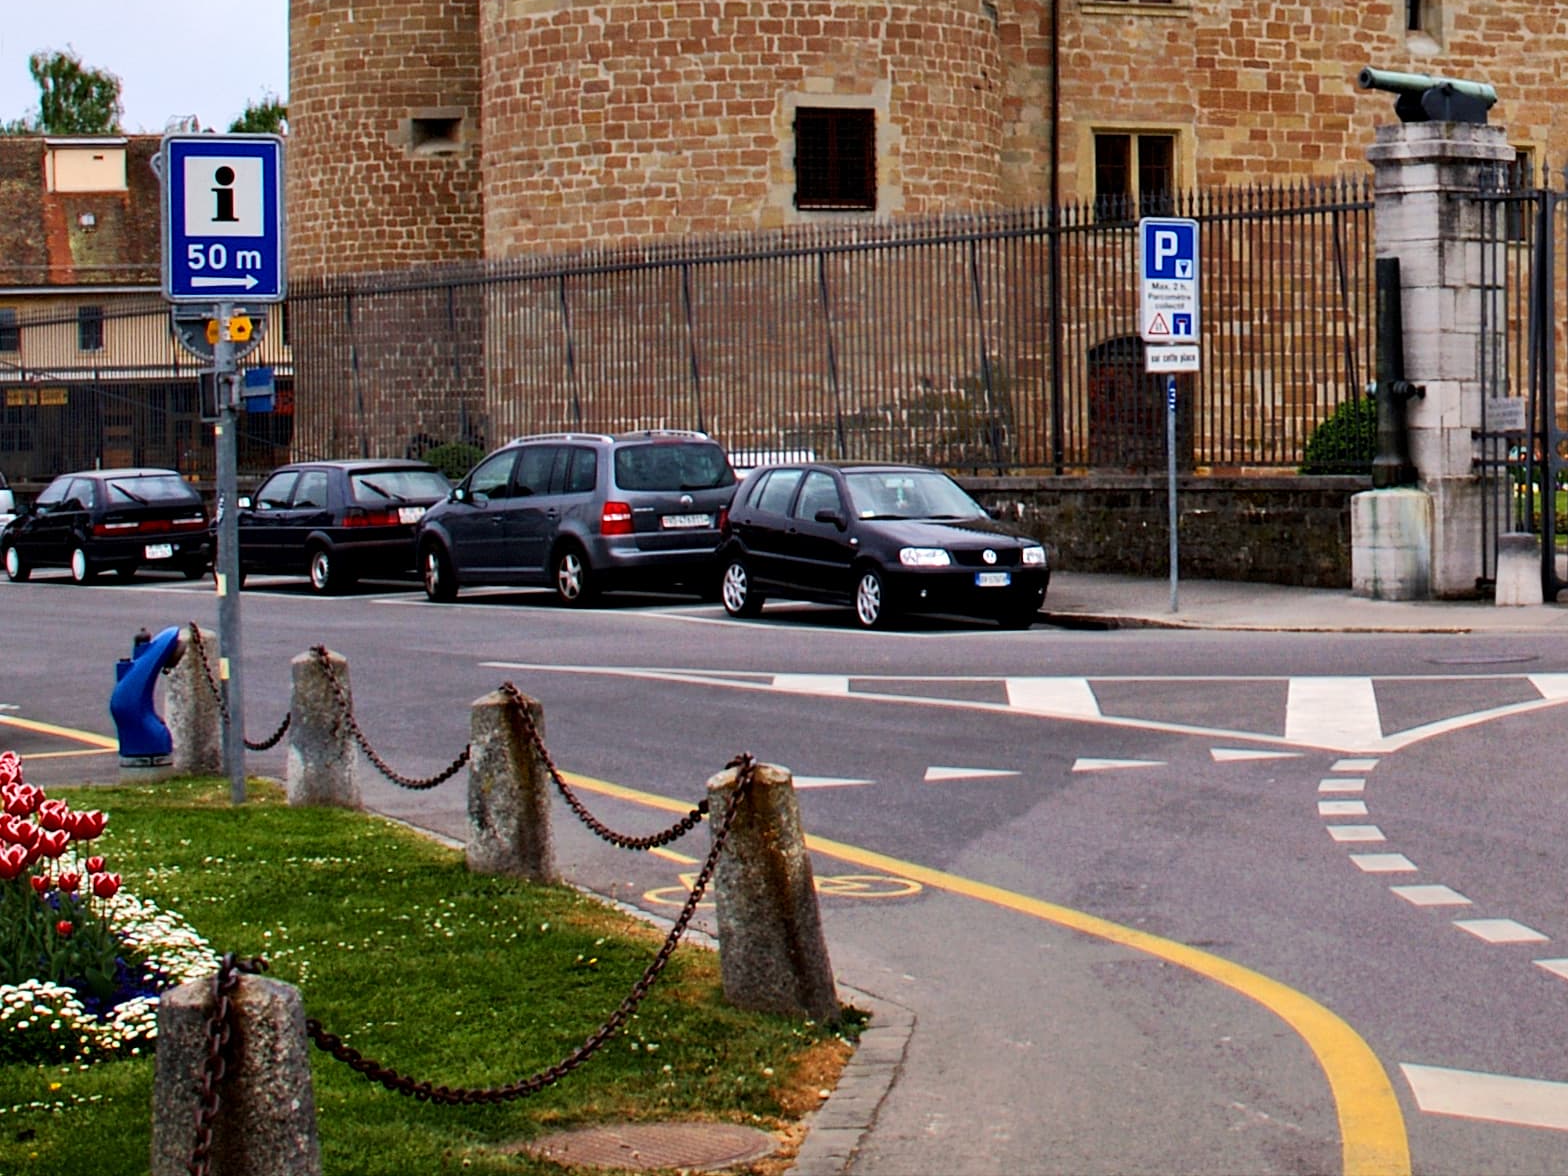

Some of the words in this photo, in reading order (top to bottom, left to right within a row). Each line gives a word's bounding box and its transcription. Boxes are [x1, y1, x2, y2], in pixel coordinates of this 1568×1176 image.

[187, 243, 228, 270] 50
[236, 250, 262, 270] m
[1154, 230, 1178, 271] P
